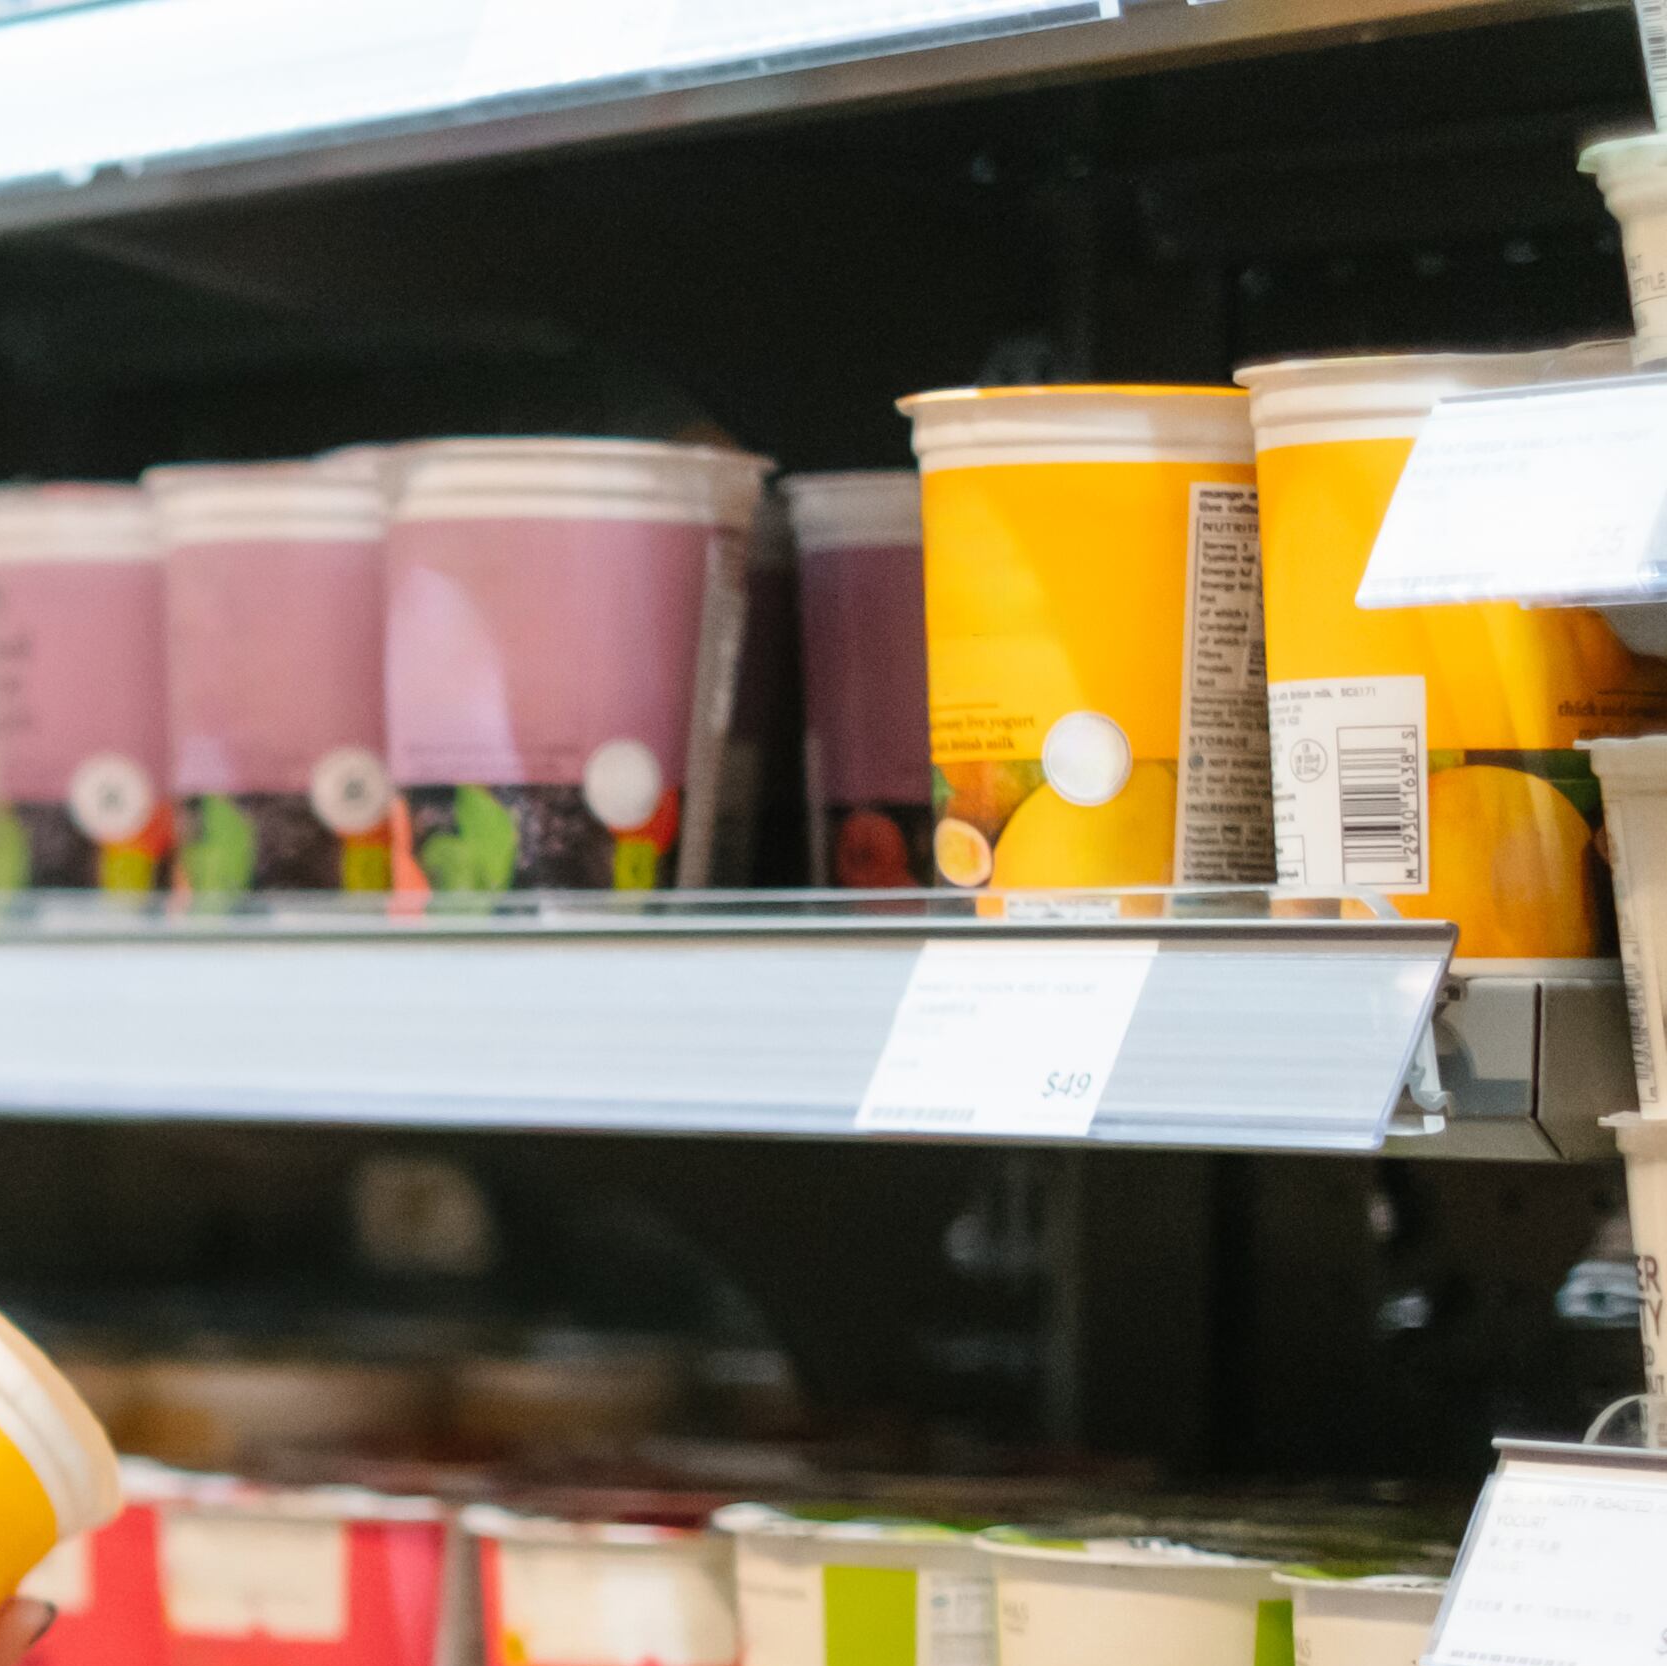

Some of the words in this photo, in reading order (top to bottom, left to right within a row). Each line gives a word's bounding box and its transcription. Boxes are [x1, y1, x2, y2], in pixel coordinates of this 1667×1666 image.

[988, 715, 1035, 732] yogurt
[985, 735, 1015, 751] milk
[1041, 1070, 1094, 1099] $49
